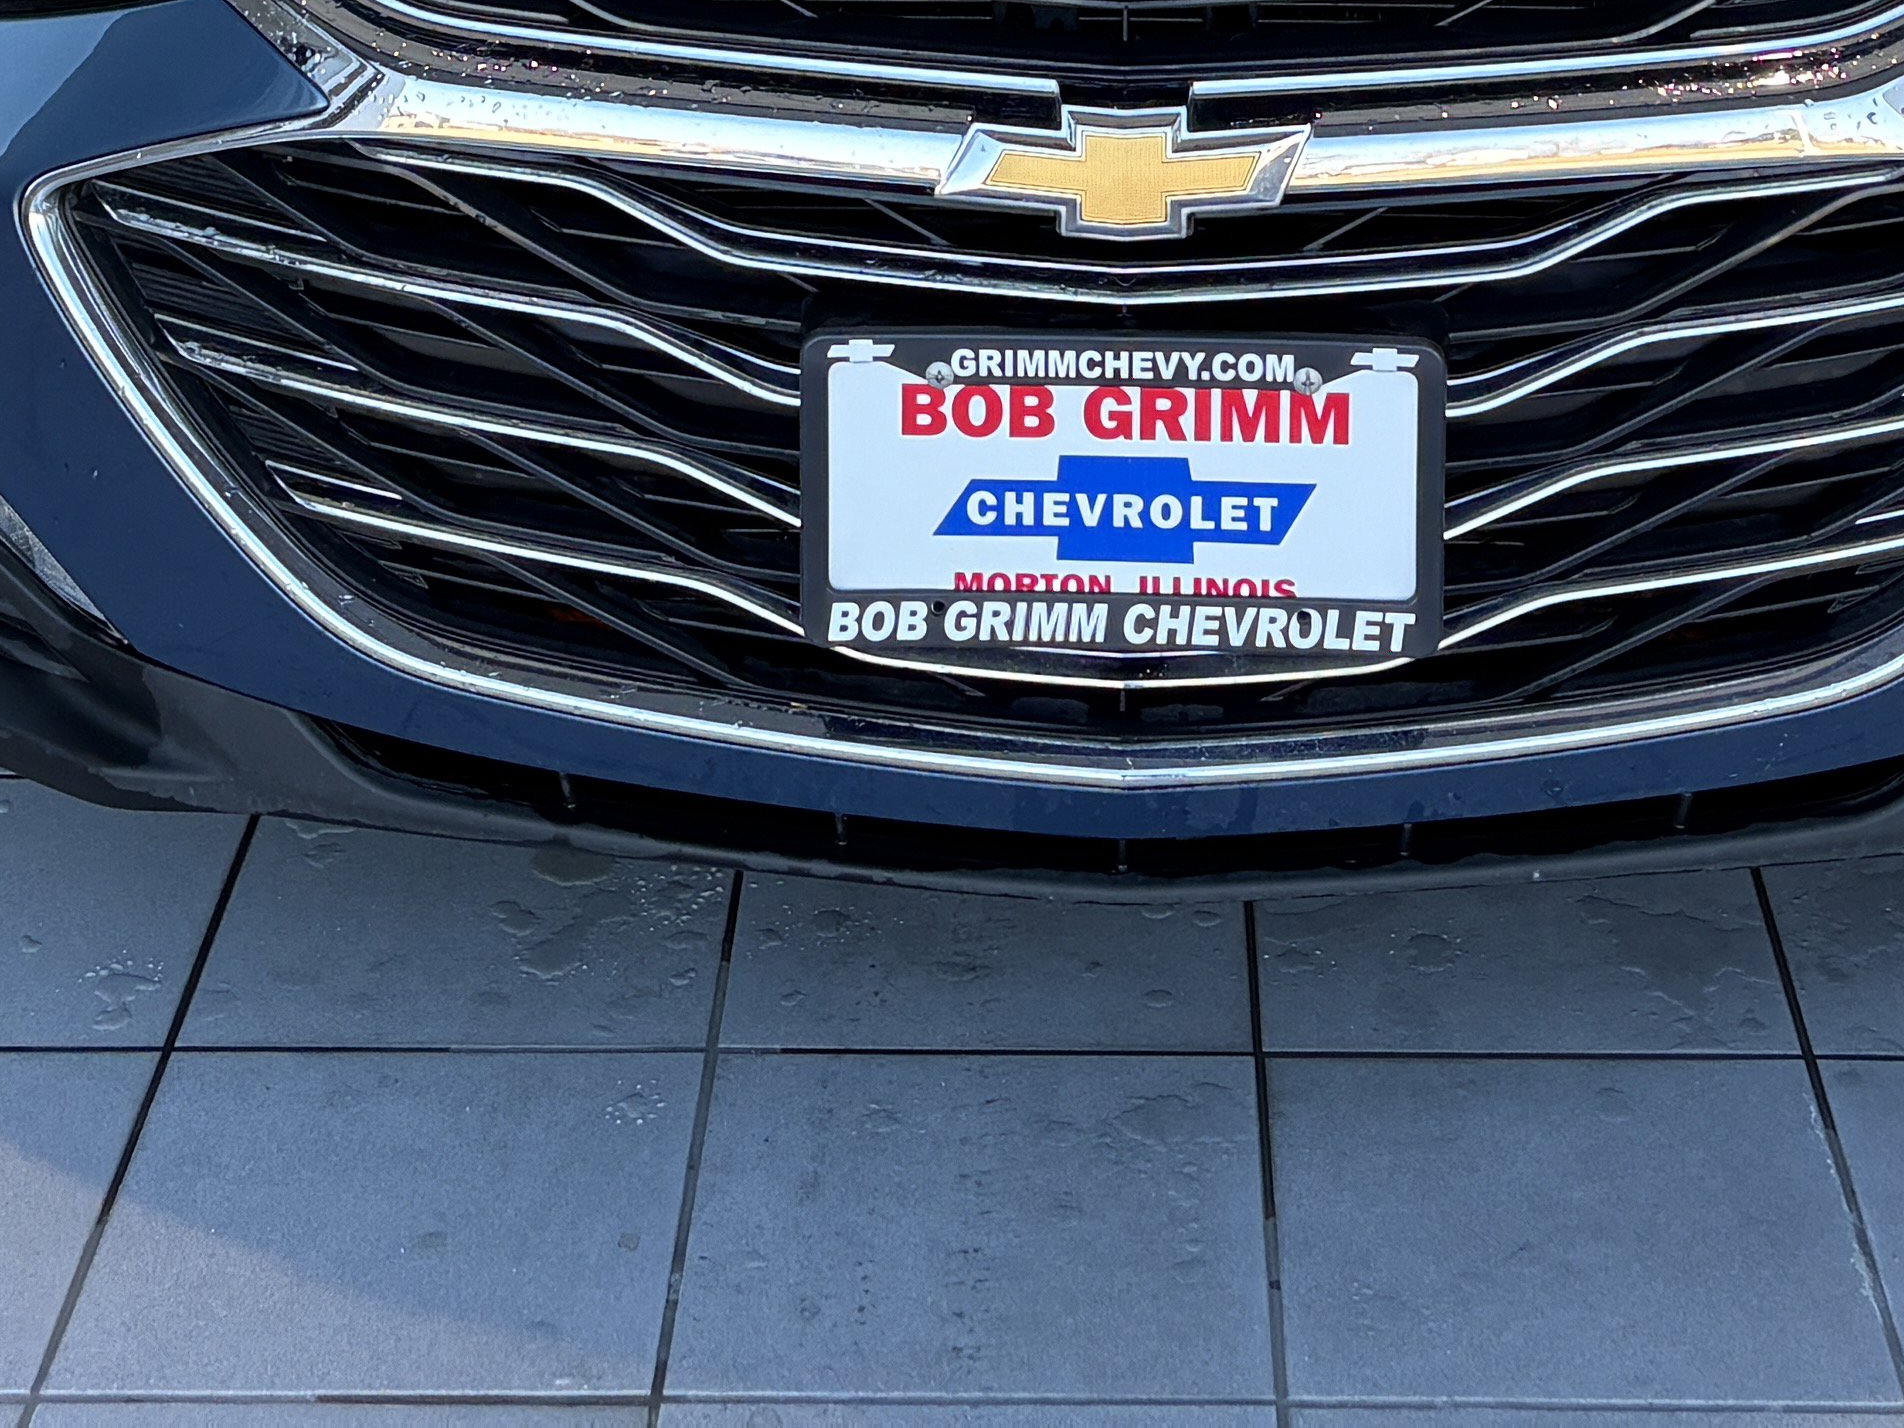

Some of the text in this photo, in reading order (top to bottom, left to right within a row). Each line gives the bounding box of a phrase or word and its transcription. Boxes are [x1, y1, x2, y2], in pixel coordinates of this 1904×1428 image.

[951, 348, 1295, 383] GRIMMCHEVY.COM
[901, 383, 1350, 445] BOB GRIMM
[966, 490, 1278, 532] CHEVROLET
[954, 572, 1297, 598] MORTON ILLINOIS
[828, 601, 1416, 653] BOB GRIMM CHEVROLET
